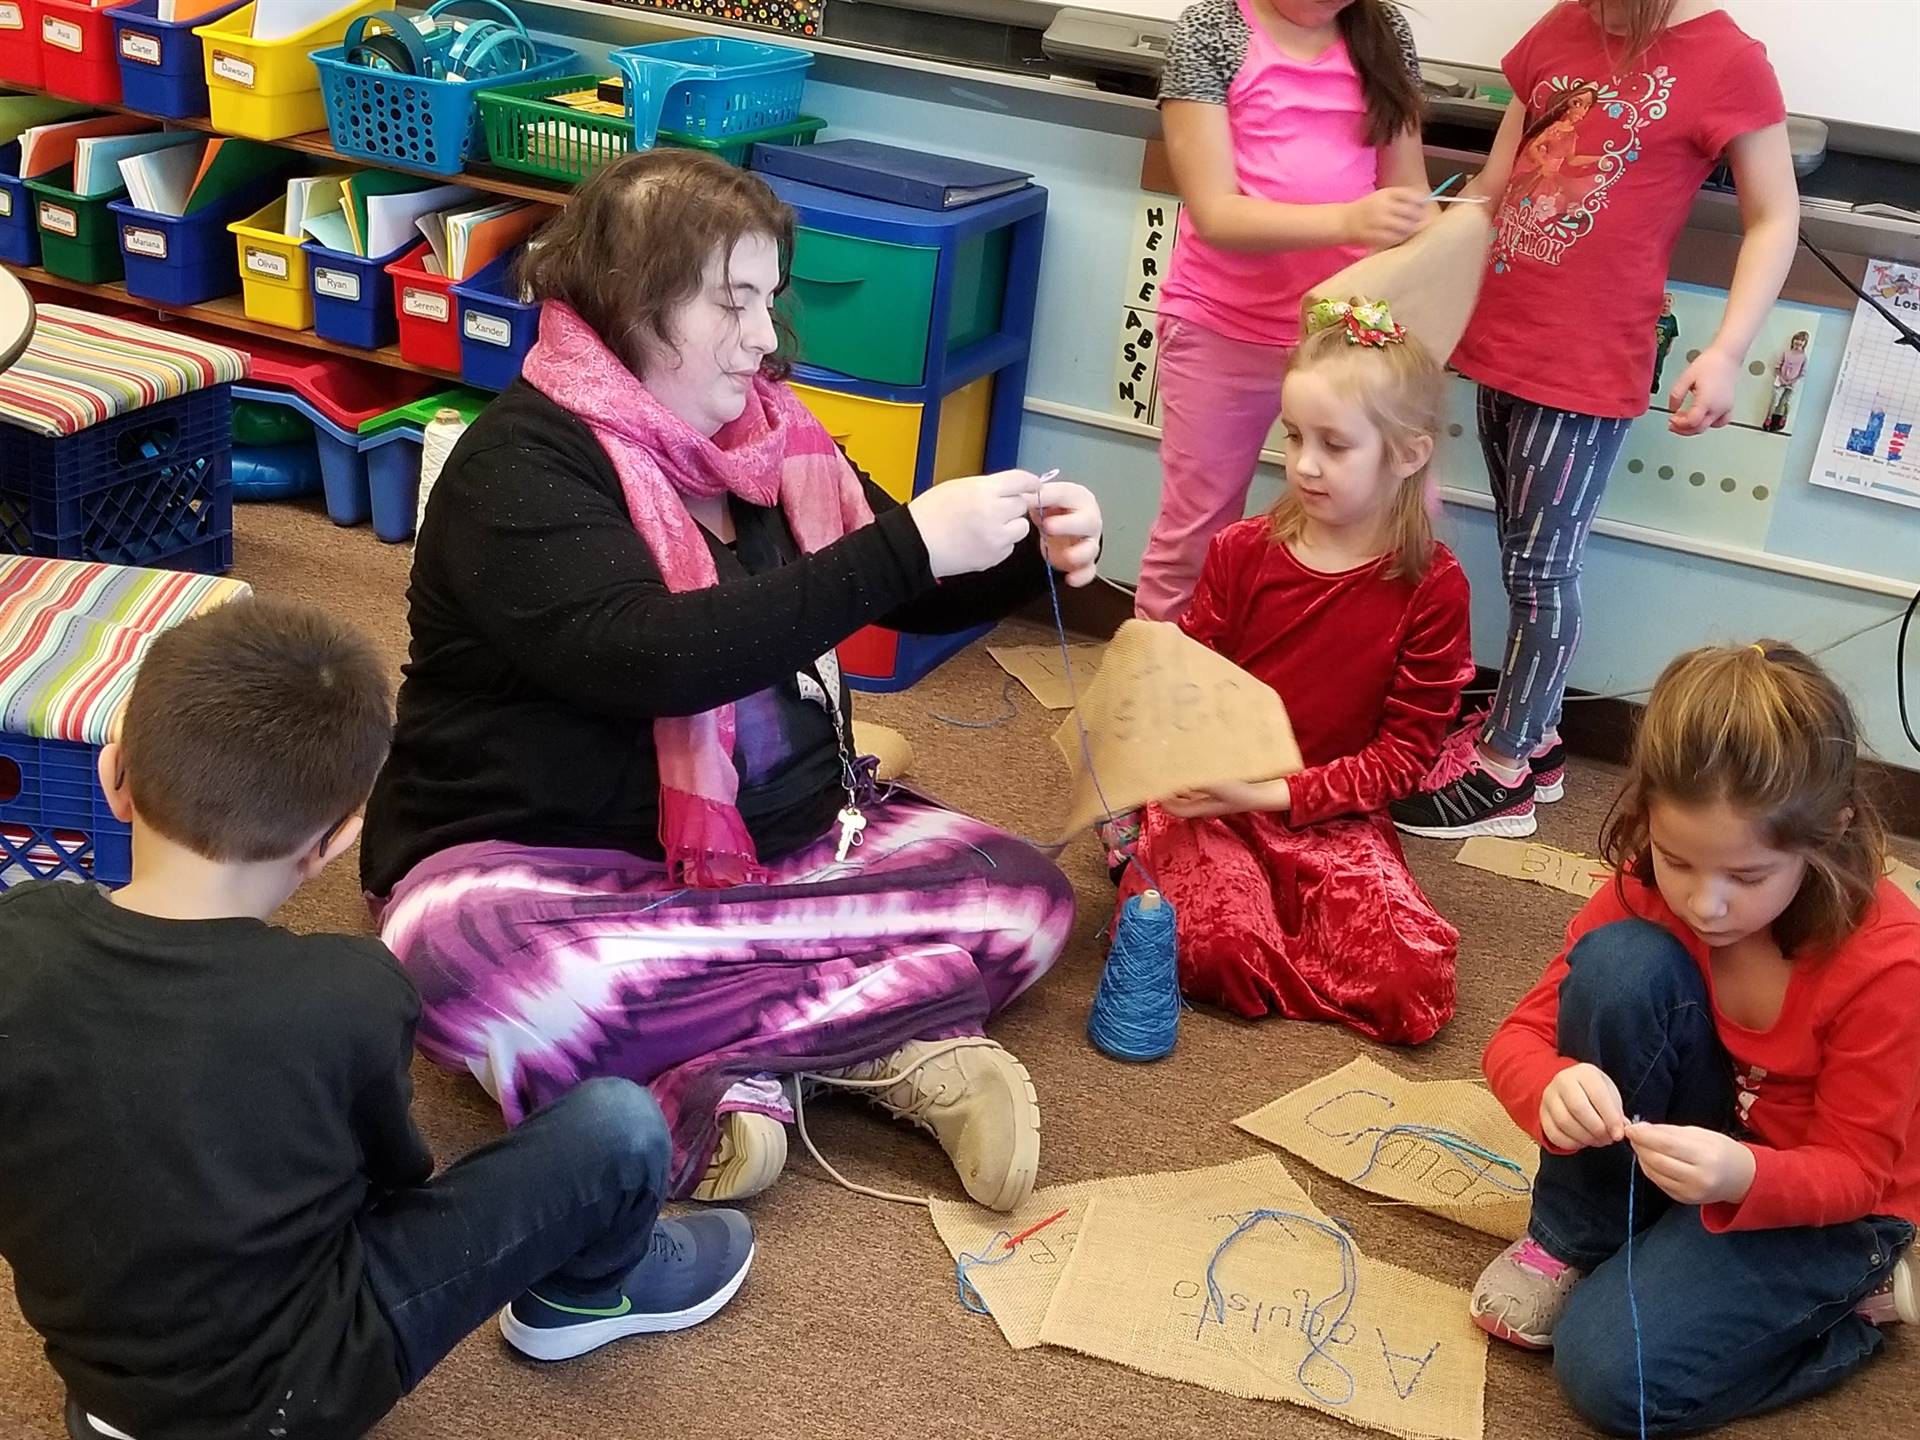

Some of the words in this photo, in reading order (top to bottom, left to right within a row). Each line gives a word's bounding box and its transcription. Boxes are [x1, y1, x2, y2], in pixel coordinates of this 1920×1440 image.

[130, 42, 153, 55] Carter
[221, 62, 250, 79] Dawson
[1138, 207, 1164, 303] HERE
[257, 257, 279, 272] Olivia
[326, 276, 348, 290] Ryan
[413, 299, 444, 316] Serenity
[1894, 295, 1920, 311] Los
[475, 321, 505, 338] Xander
[1118, 310, 1154, 419] ABSENT
